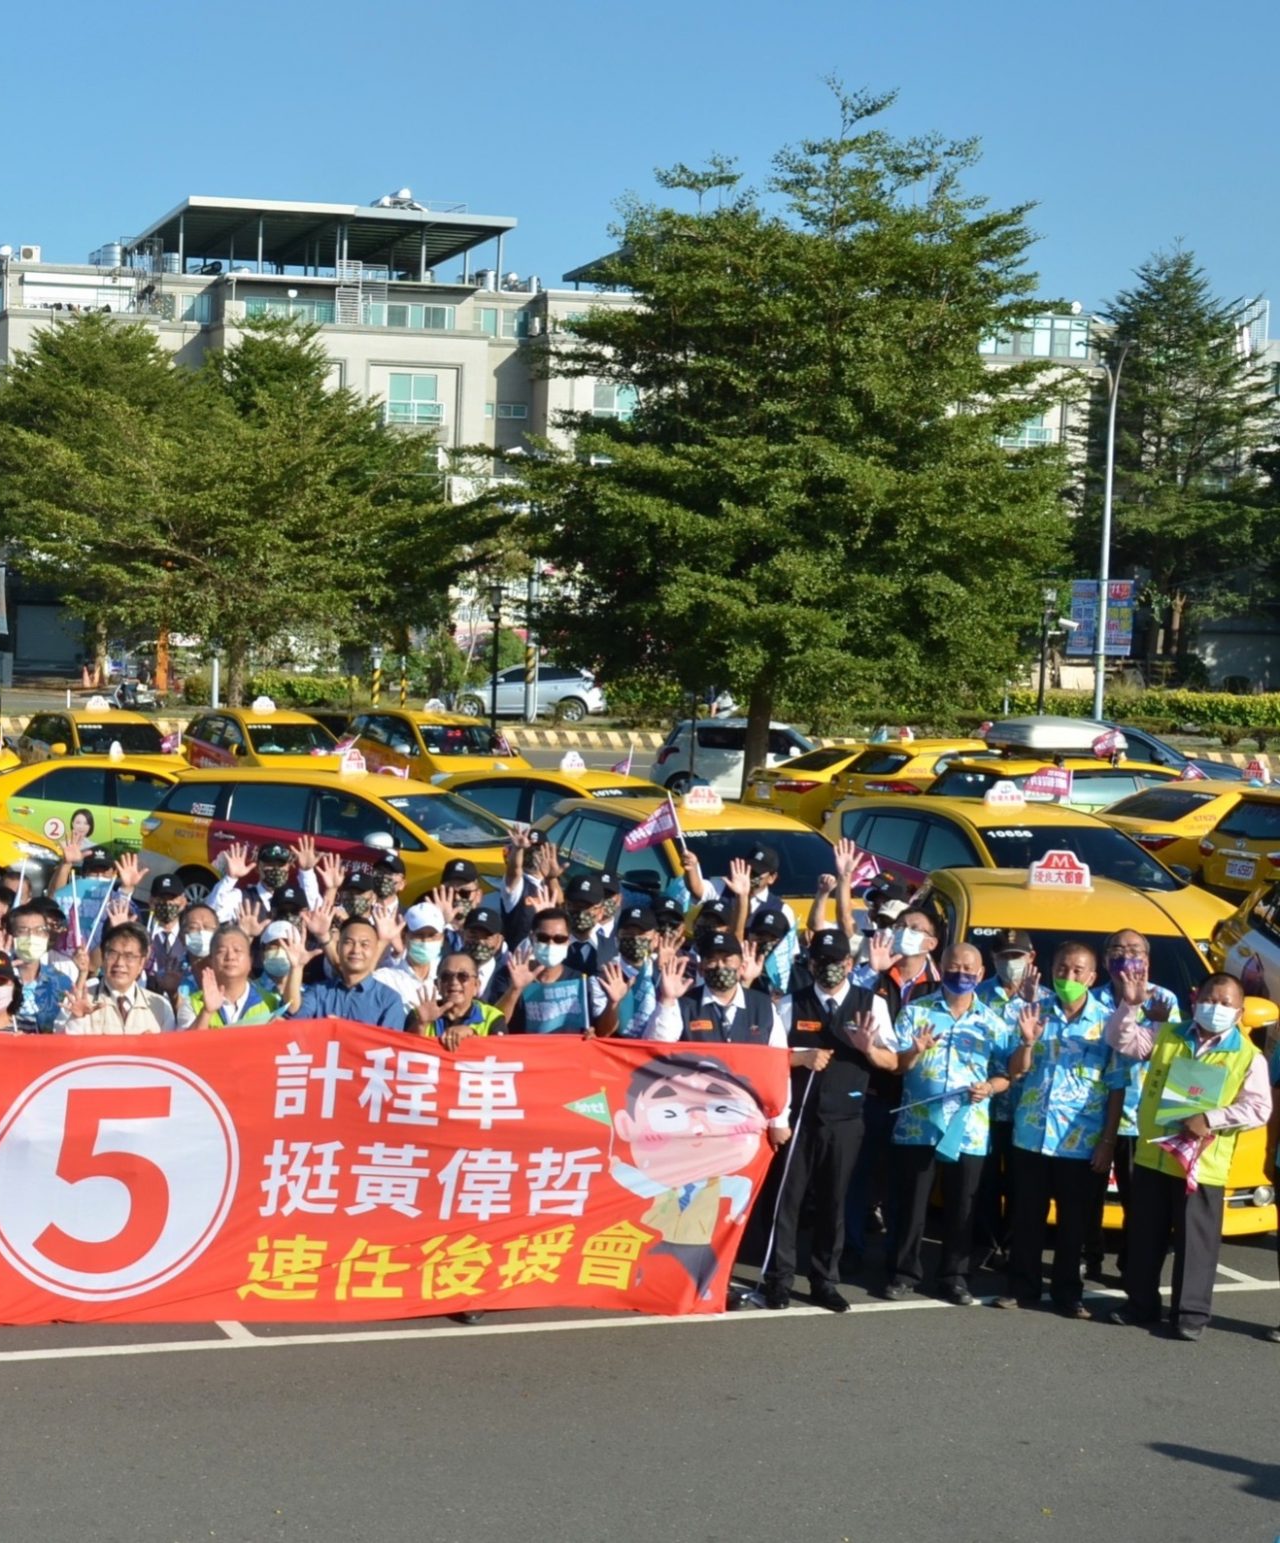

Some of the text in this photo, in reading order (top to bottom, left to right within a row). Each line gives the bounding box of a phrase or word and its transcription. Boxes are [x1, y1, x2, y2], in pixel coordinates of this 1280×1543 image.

[49, 821, 61, 837] 2
[1052, 855, 1067, 868] M
[1033, 870, 1085, 884] 優良大都會
[273, 1040, 526, 1130] 計程車
[31, 1087, 172, 1244] 5
[258, 1139, 603, 1221] 挺黃偉哲
[236, 1221, 655, 1302] 連任後援會
